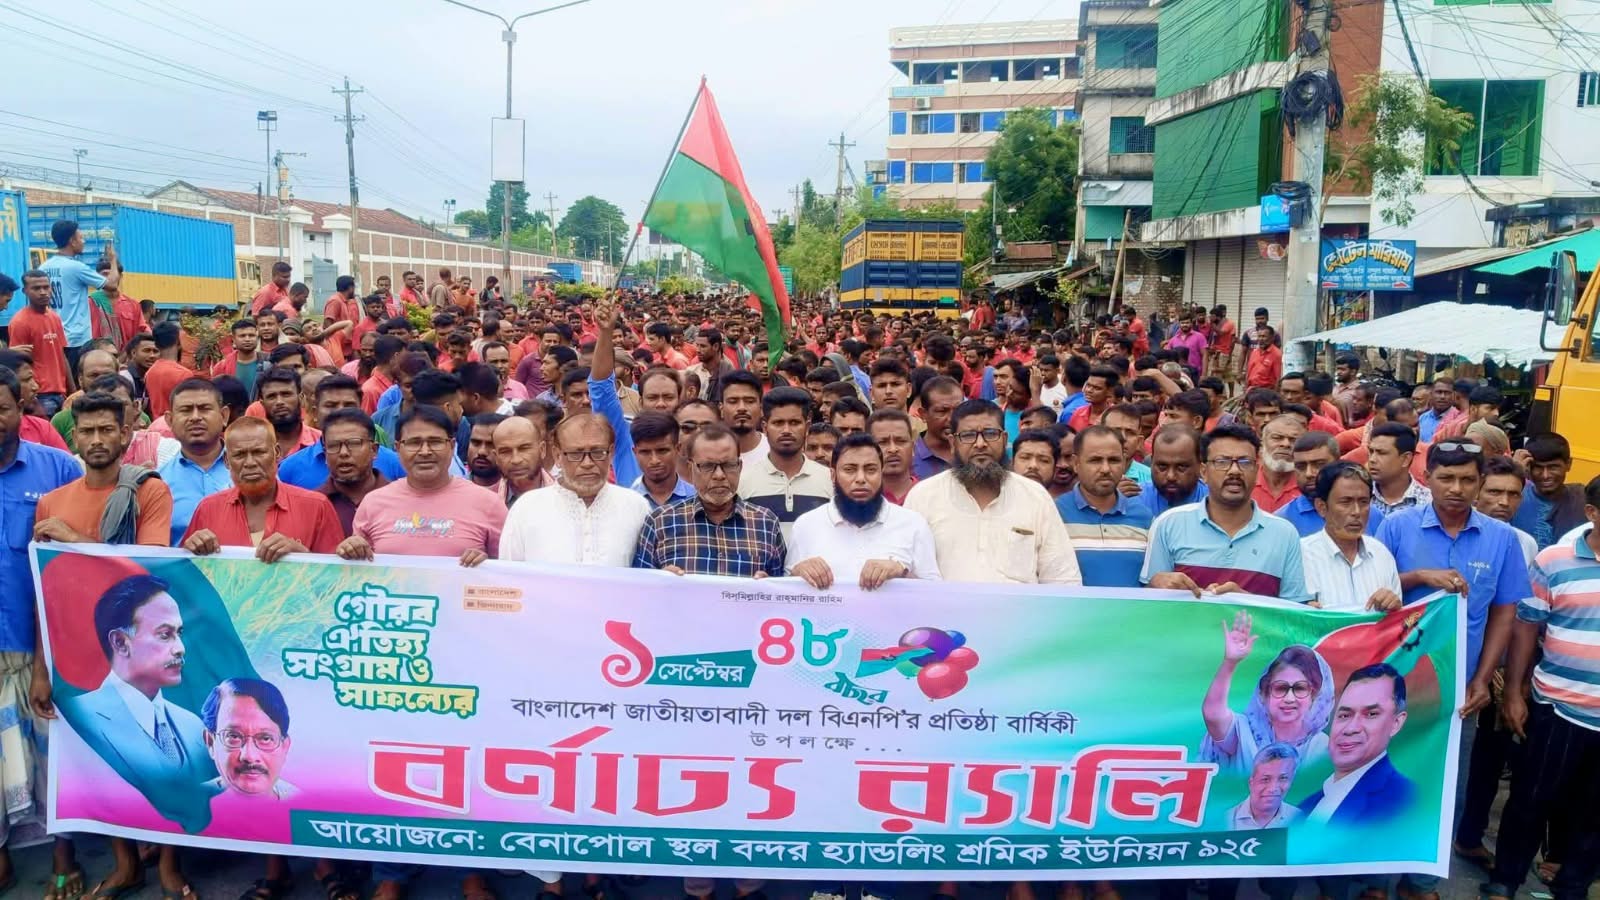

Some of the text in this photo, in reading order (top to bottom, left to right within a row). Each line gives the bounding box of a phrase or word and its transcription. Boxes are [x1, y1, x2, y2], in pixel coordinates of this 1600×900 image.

[337, 584, 436, 626] গৌরব
[326, 622, 427, 659] ঐতিহ্য
[757, 617, 849, 667] ৪৮
[285, 650, 430, 683] সংগ্রাম ও
[658, 658, 746, 684] সেপ্টেম্বর
[337, 681, 476, 717] সাফল্যের
[511, 698, 617, 720] বাংলাদেশ
[624, 699, 769, 726] জাতীয়তাবাদী
[776, 708, 813, 728] দল
[928, 708, 998, 733] প্রতিষ্ঠা
[1006, 711, 1077, 735] বার্ষিকী
[369, 726, 804, 820] বর্ণাঢ্য
[309, 819, 1262, 865] আয়োজনে: বেনাপোল স্থল বন্দর হ্যান্ডলিং শ্রমিক ইউনিয়ন ৯২৫
